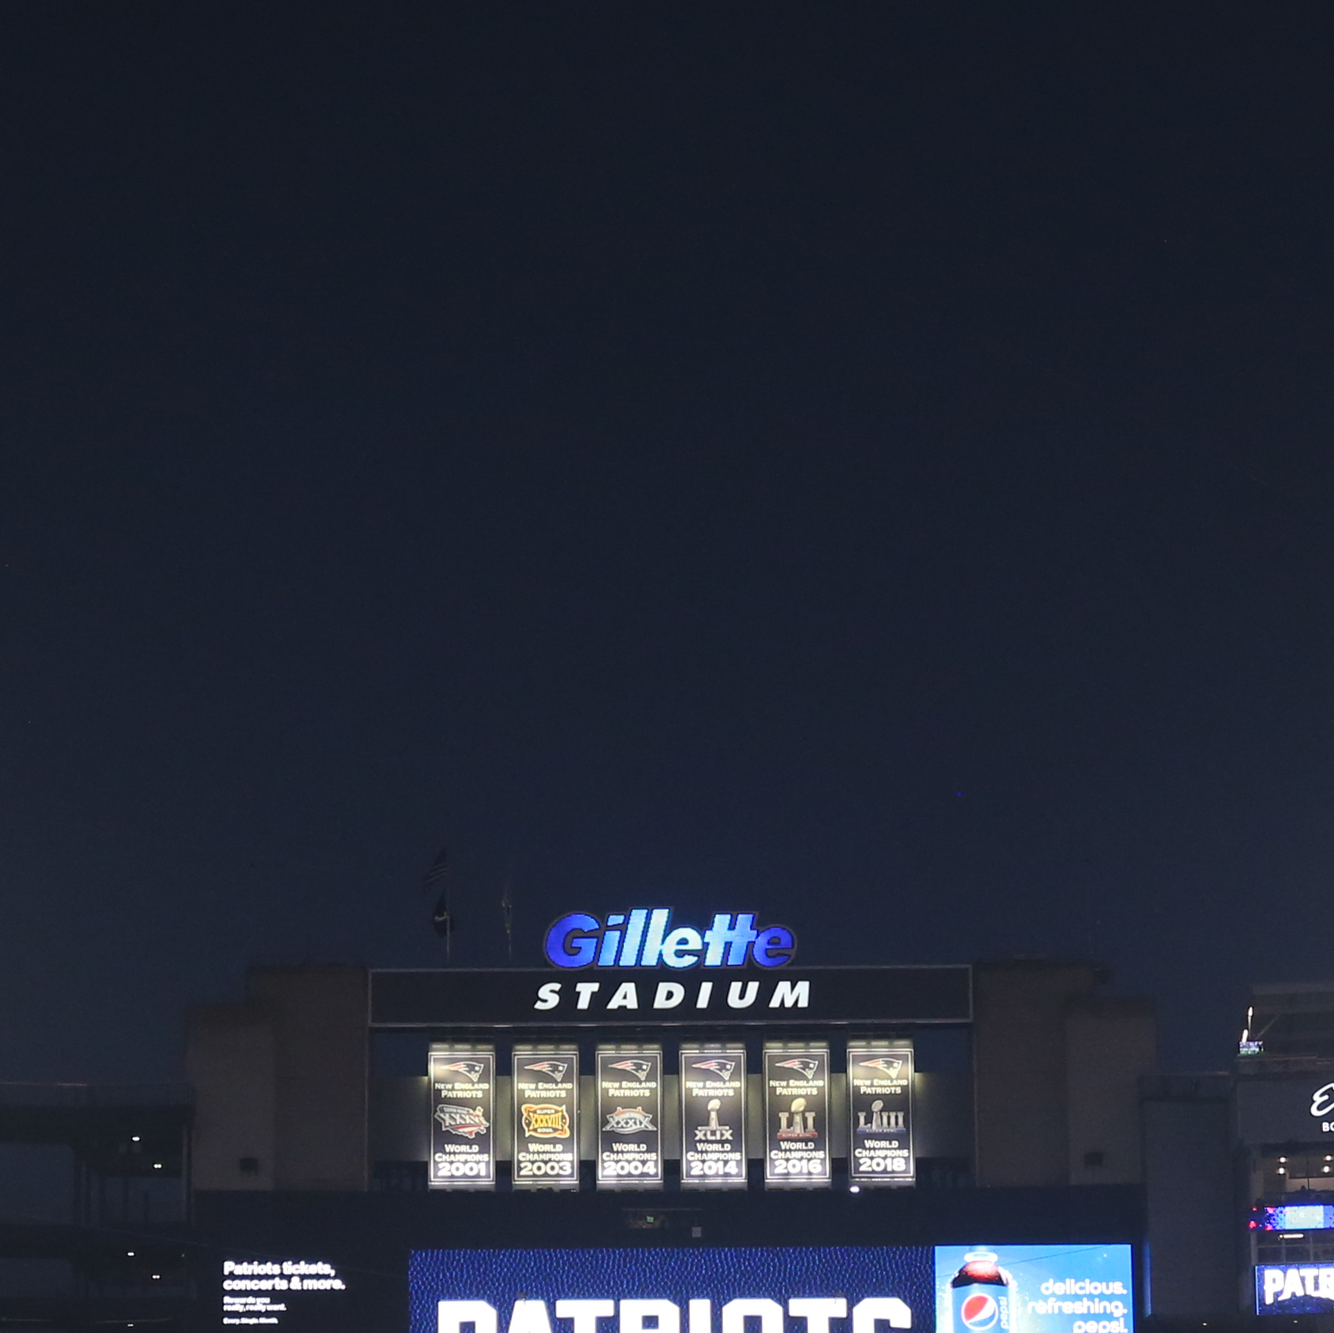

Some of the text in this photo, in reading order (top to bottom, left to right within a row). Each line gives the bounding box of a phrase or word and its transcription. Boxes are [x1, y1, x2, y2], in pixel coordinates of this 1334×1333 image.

[546, 909, 794, 968] Gillette
[534, 981, 810, 1010] STADIUM
[602, 1081, 656, 1089] NEW ENGLAND
[441, 1090, 483, 1098] PATRIOTS
[525, 1090, 566, 1098] PATRIOTS
[609, 1089, 650, 1097] PATRIOTS
[692, 1088, 734, 1097] PATRIOTS
[776, 1087, 818, 1095] PATRIOTS
[860, 1086, 901, 1094] PATRIOTS
[694, 1130, 733, 1140] XLIX
[444, 1144, 479, 1153] WORLD
[528, 1143, 563, 1152] WORLD
[612, 1143, 647, 1152] WORLD
[696, 1142, 731, 1151] WORLD
[780, 1141, 814, 1150] WORLD
[864, 1140, 898, 1149] WORLD
[435, 1153, 489, 1161] CHAMPIONS
[518, 1152, 572, 1161] CHAMPIONS
[602, 1152, 657, 1161] CHAMPIONS
[687, 1151, 741, 1161] CHAMPIONS
[770, 1150, 825, 1159] CHAMPIONS
[855, 1149, 909, 1158] CHAMPIONS
[437, 1162, 486, 1176] 2001
[519, 1161, 571, 1175] 2003
[603, 1161, 656, 1175] 2004
[690, 1161, 738, 1175] 2014
[774, 1160, 822, 1173] 2016
[859, 1158, 906, 1172] 2018
[223, 1261, 336, 1277] Patriots tickets,
[223, 1276, 346, 1290] concerts & more.
[1040, 1279, 1127, 1297] delicious.
[256, 1297, 270, 1306] you
[1000, 1296, 1009, 1329] pepsi
[1027, 1298, 1128, 1318] refreshing.
